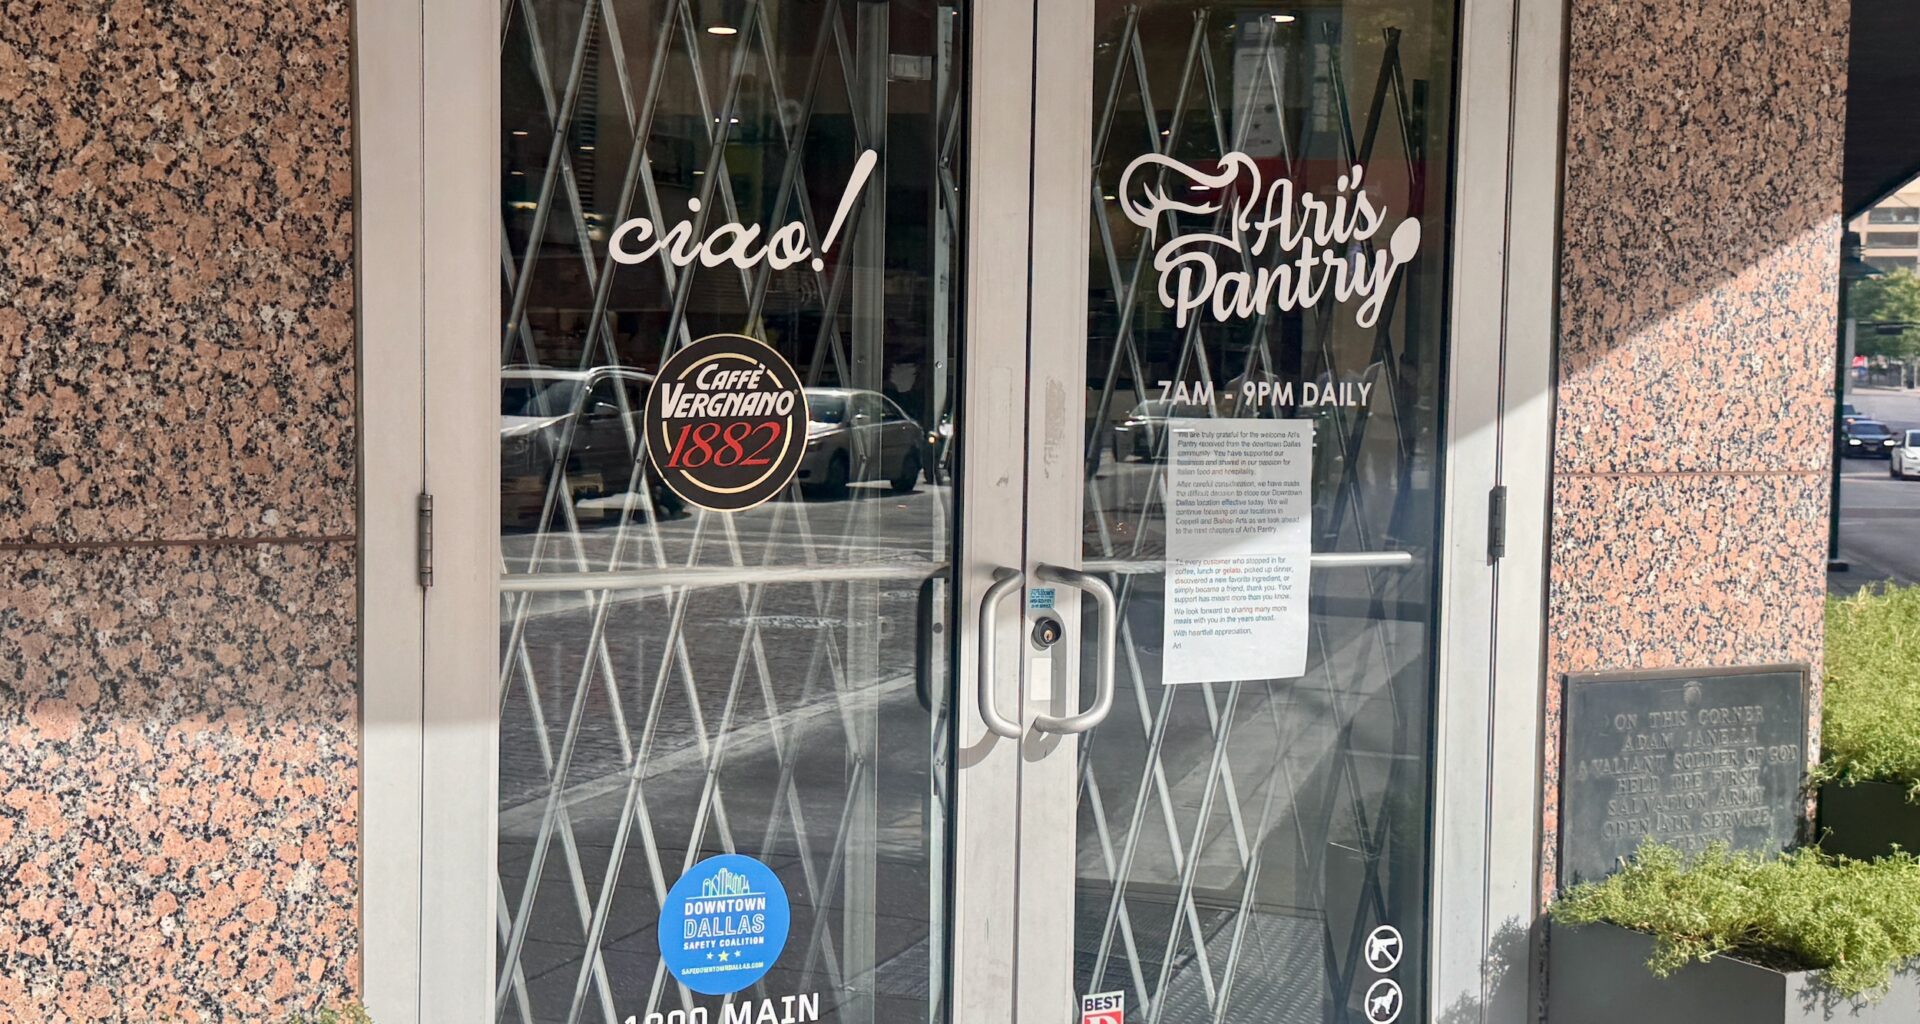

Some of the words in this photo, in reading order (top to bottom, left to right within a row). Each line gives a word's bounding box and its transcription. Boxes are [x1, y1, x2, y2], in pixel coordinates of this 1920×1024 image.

[609, 149, 878, 272] ciao!
[1251, 164, 1387, 256] Ari's
[1154, 236, 1392, 328] Pantry
[661, 382, 796, 419] VERGNANO
[1157, 380, 1215, 407] 7AM
[1242, 380, 1294, 407] 9PM
[1302, 381, 1372, 407] DAILY
[664, 421, 782, 468] 1882
[1614, 713, 1638, 730] ON
[1649, 710, 1689, 728] THIS
[1698, 705, 1764, 726] CORNER
[1621, 732, 1674, 752] ADAM
[1591, 754, 1667, 778] VALIANT
[1673, 749, 1740, 771] SOLDIER
[1744, 746, 1765, 766] OF
[1767, 744, 1799, 765] GOD
[1616, 775, 1659, 796] HELD
[1671, 771, 1702, 791] THE
[1711, 766, 1760, 786] FIRST
[1607, 791, 1708, 817] SALVATION
[1717, 785, 1766, 807] ARMY
[1602, 817, 1651, 840] OPEN
[1701, 806, 1770, 828] SERVICE
[684, 897, 766, 916] DOWNTOWN
[683, 913, 765, 939] DALLAS
[683, 939, 716, 951] SAFETY
[719, 936, 765, 947] COALITION
[725, 992, 819, 1024] MAIN
[1084, 995, 1122, 1012] BEST
